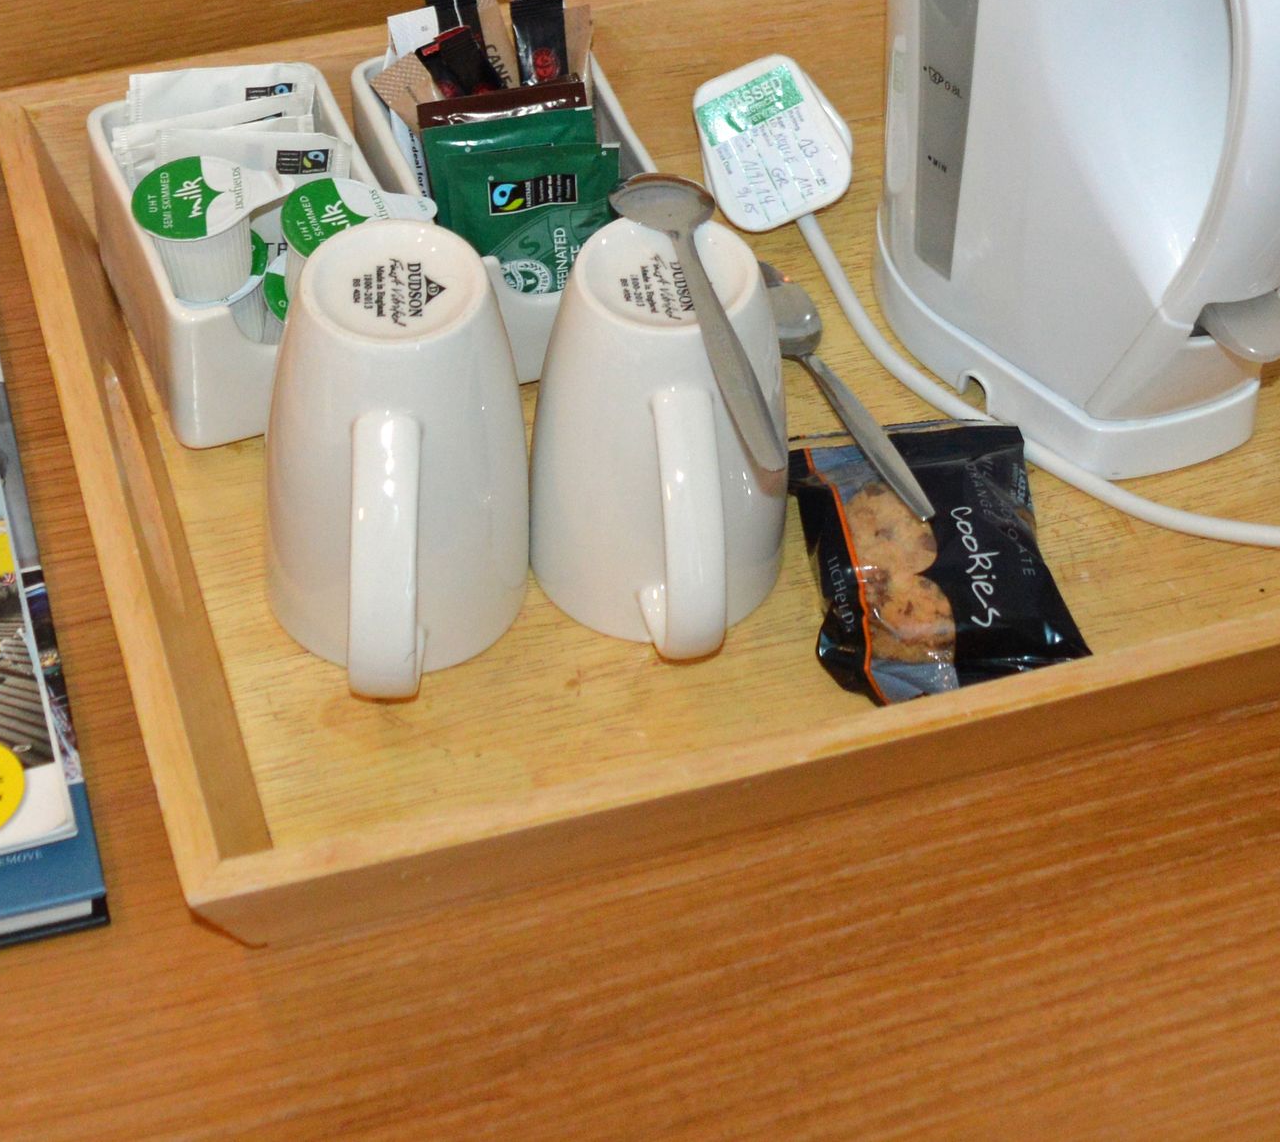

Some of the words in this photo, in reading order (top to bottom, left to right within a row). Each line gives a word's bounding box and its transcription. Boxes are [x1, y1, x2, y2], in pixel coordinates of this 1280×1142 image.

[147, 194, 158, 213] UHT
[159, 171, 172, 209] SKIMMED
[172, 176, 204, 218] milk
[162, 210, 173, 229] SEMI
[296, 219, 312, 241] UHT
[299, 195, 325, 238] SKIMMED
[376, 265, 385, 283] Made
[407, 262, 422, 318] DUDSON
[640, 265, 650, 283] Made
[646, 291, 659, 314] England
[669, 261, 695, 312] DUDSON
[374, 291, 386, 318] England
[949, 505, 1002, 628] cookies
